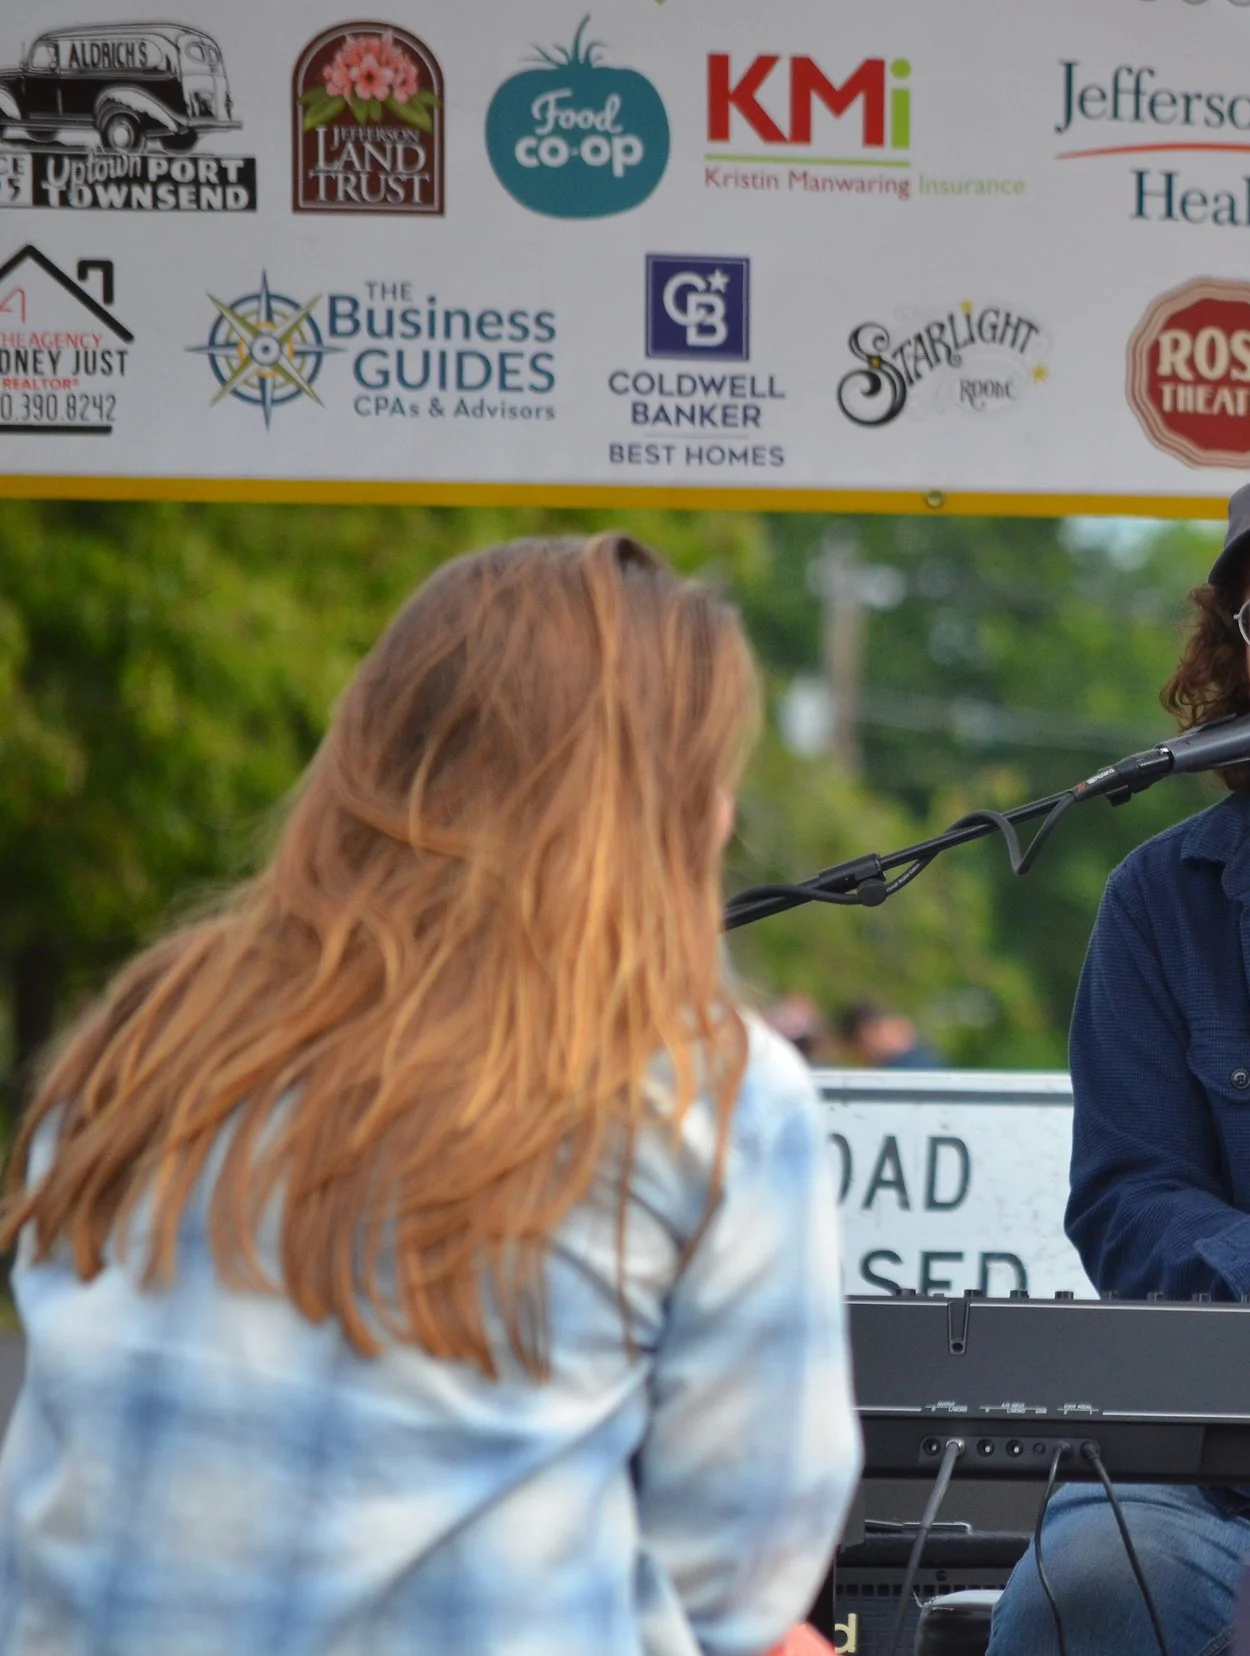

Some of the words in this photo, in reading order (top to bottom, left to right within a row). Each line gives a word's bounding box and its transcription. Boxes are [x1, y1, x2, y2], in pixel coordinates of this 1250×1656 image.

[531, 88, 622, 136] Food
[707, 54, 911, 149] KMi
[315, 127, 426, 173] LAND
[46, 152, 141, 191] Uptown
[148, 158, 244, 184] PORT
[308, 171, 431, 204] TRUST
[704, 168, 780, 191] Kristin
[788, 170, 910, 201] Manwaring
[918, 175, 1026, 198] Insurance
[42, 181, 249, 210] TOWNSEND
[364, 281, 413, 302] THE
[328, 294, 556, 343] Business
[72, 349, 128, 377] JUST
[353, 348, 556, 393] GUIDES
[837, 308, 1039, 427] STARLIGHT
[607, 371, 786, 398] COLDWELL
[353, 396, 420, 418] CPAs
[428, 397, 445, 417] &
[454, 399, 556, 421] Advisors
[631, 402, 761, 428] BANKER
[609, 444, 676, 466] BEST
[686, 446, 785, 468] HOMES
